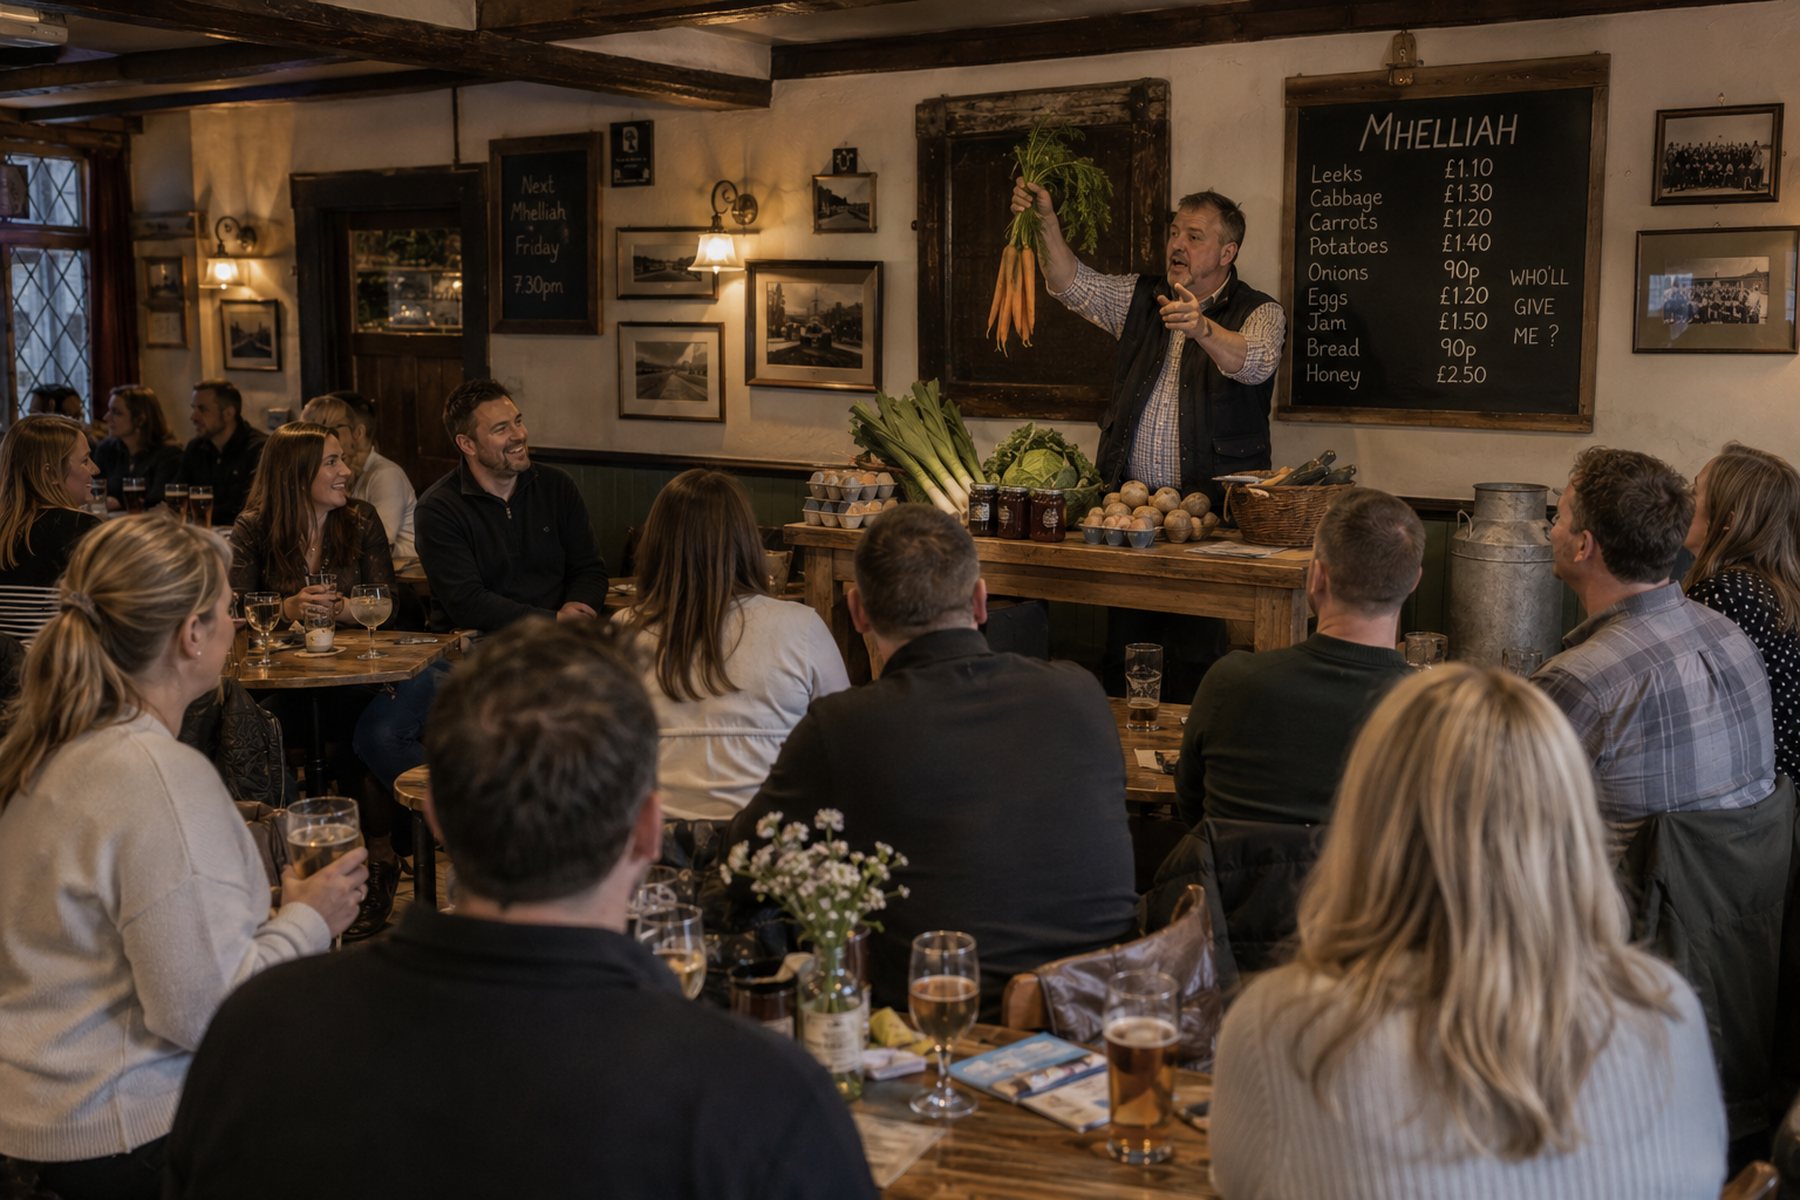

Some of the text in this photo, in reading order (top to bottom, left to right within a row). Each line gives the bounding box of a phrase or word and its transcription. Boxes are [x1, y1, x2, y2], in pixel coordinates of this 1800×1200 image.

[1358, 112, 1518, 152] MHELLIAH
[1311, 157, 1494, 184] Leeks £1.10
[521, 175, 555, 194] Next
[1310, 183, 1493, 213] Cabbage £1.30
[510, 201, 567, 221] Mhelliah
[1309, 208, 1492, 232] Carrots £1.20
[515, 234, 560, 263] Friday
[1309, 236, 1388, 255] Potatoes
[1308, 260, 1480, 285] Onions 90p
[1510, 265, 1569, 286] WHO'LL
[513, 275, 564, 301] 7.30pm
[1308, 286, 1489, 313] Eggs £1.20
[1514, 298, 1555, 316] GIVE
[1307, 312, 1488, 332] Jam £1.50
[1513, 324, 1560, 348] ME ?
[1306, 338, 1476, 364] Bread 90p
[1306, 364, 1487, 391] Honey £2.50
